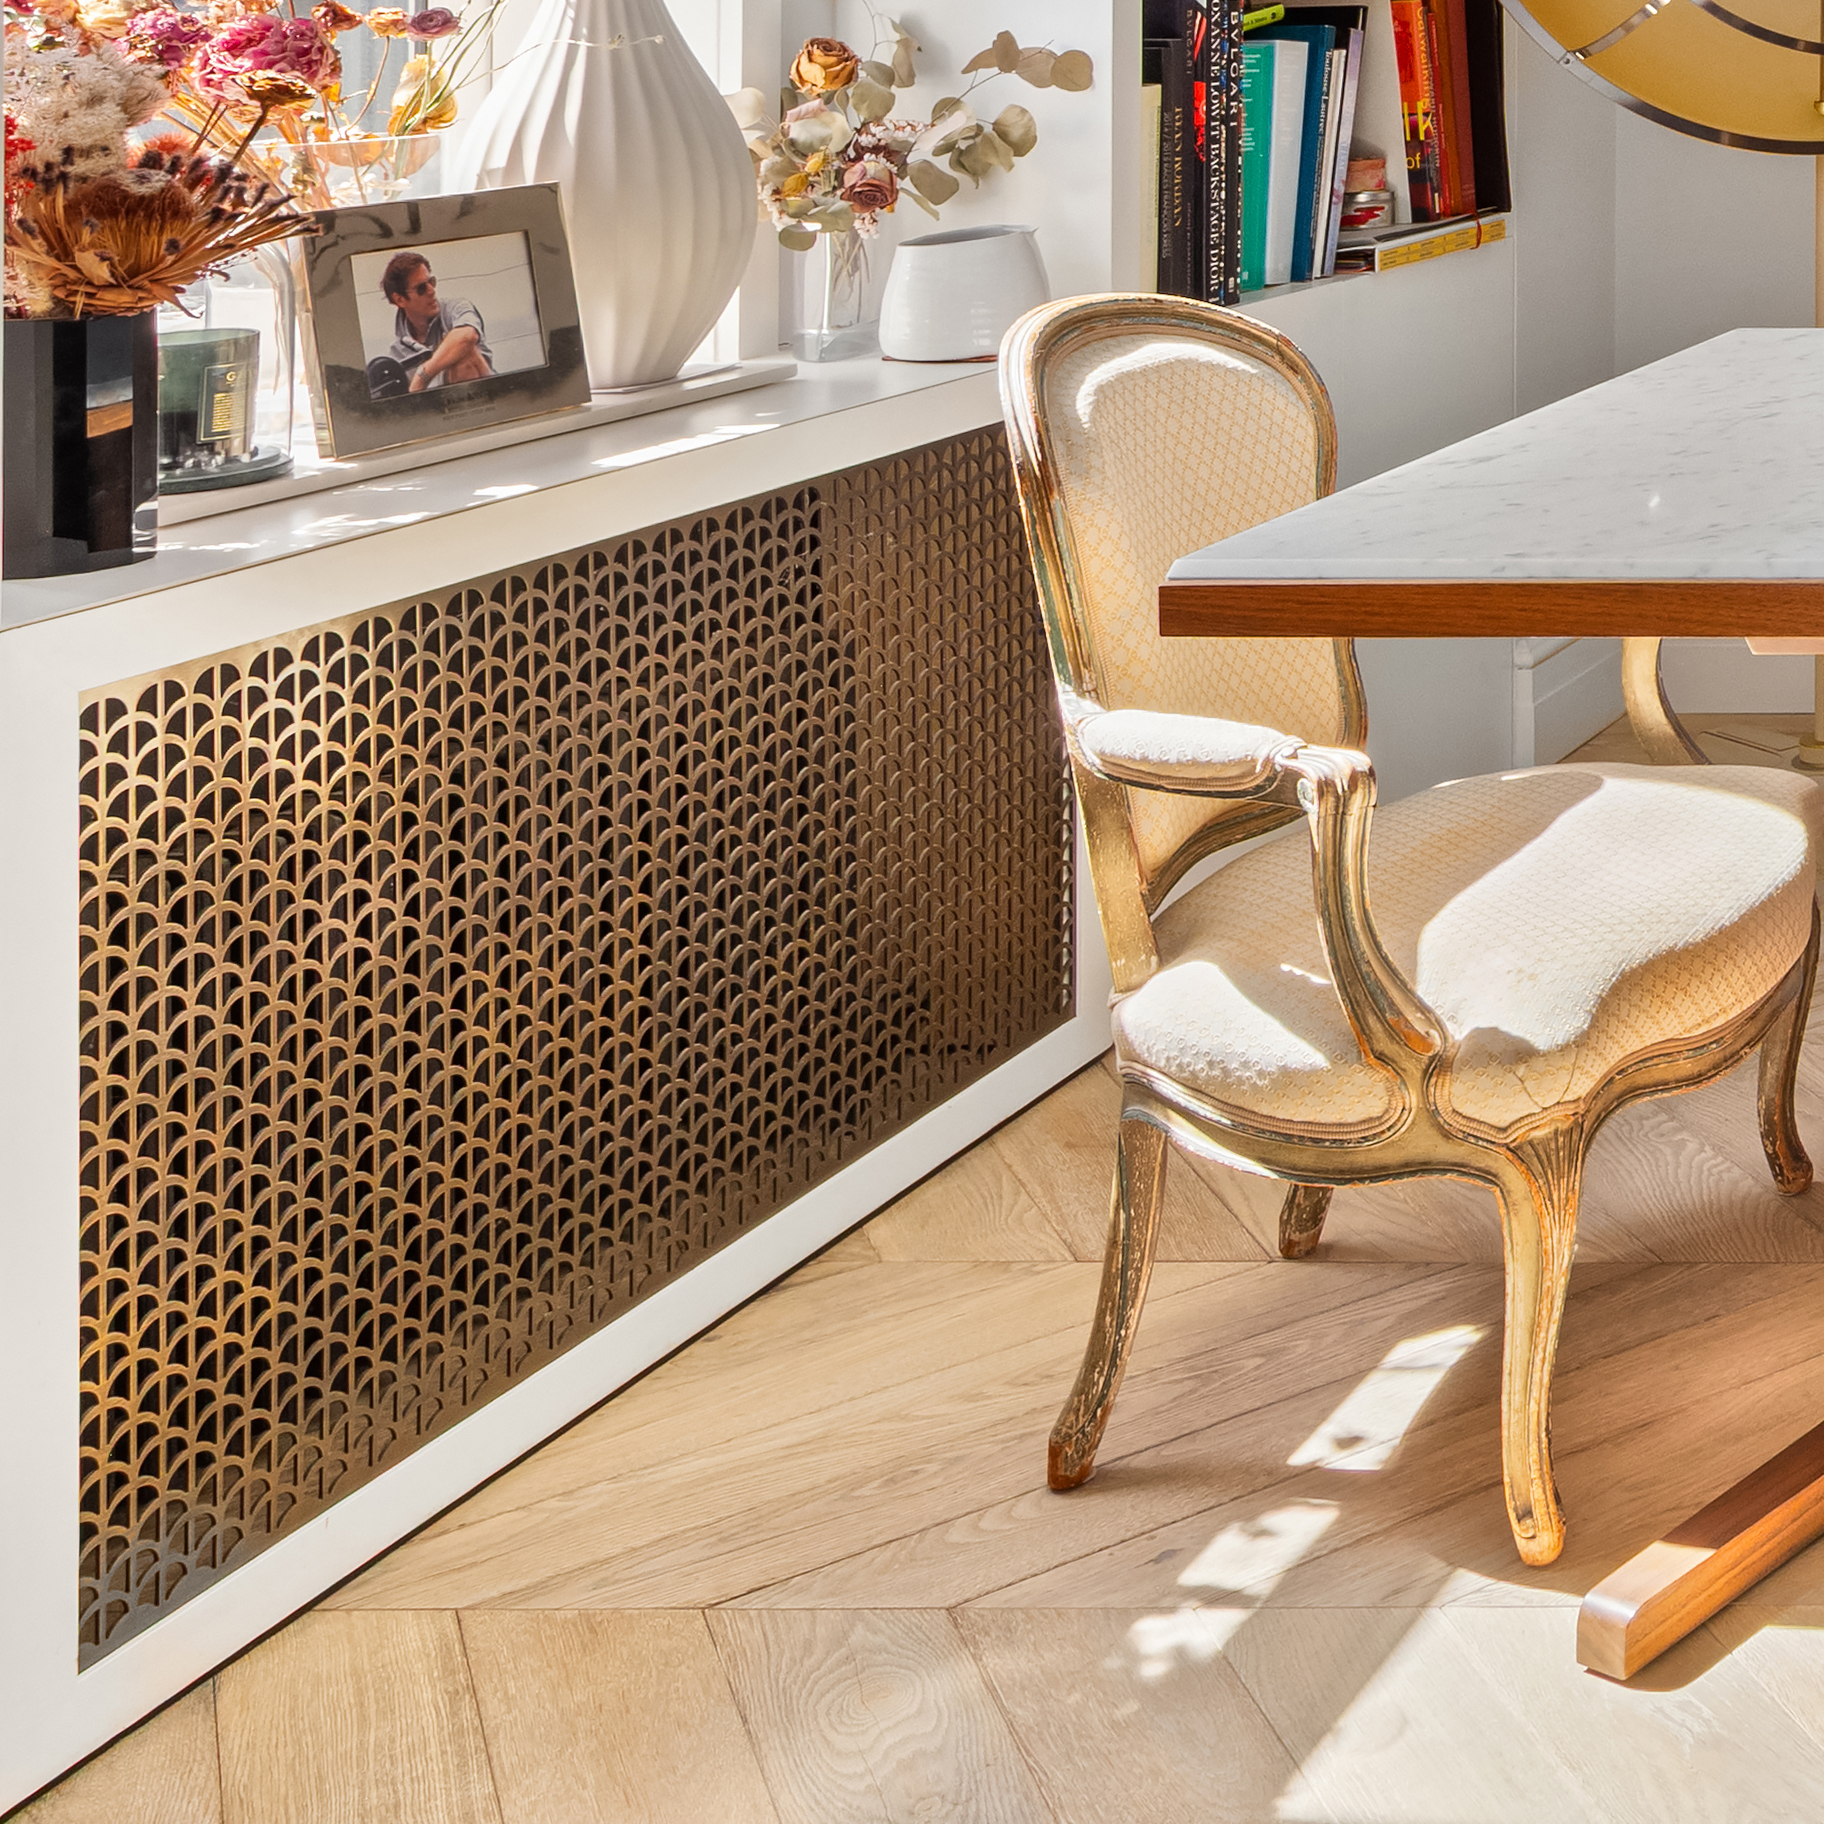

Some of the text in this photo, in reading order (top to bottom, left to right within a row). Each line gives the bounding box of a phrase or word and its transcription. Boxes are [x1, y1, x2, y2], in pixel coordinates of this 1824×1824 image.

[1210, 81, 1219, 140] LOWIT
[1318, 49, 1331, 134] Toulouse-Lautrec
[1210, 143, 1219, 244] BACKSTAGE
[1210, 248, 1219, 293] DIOR
